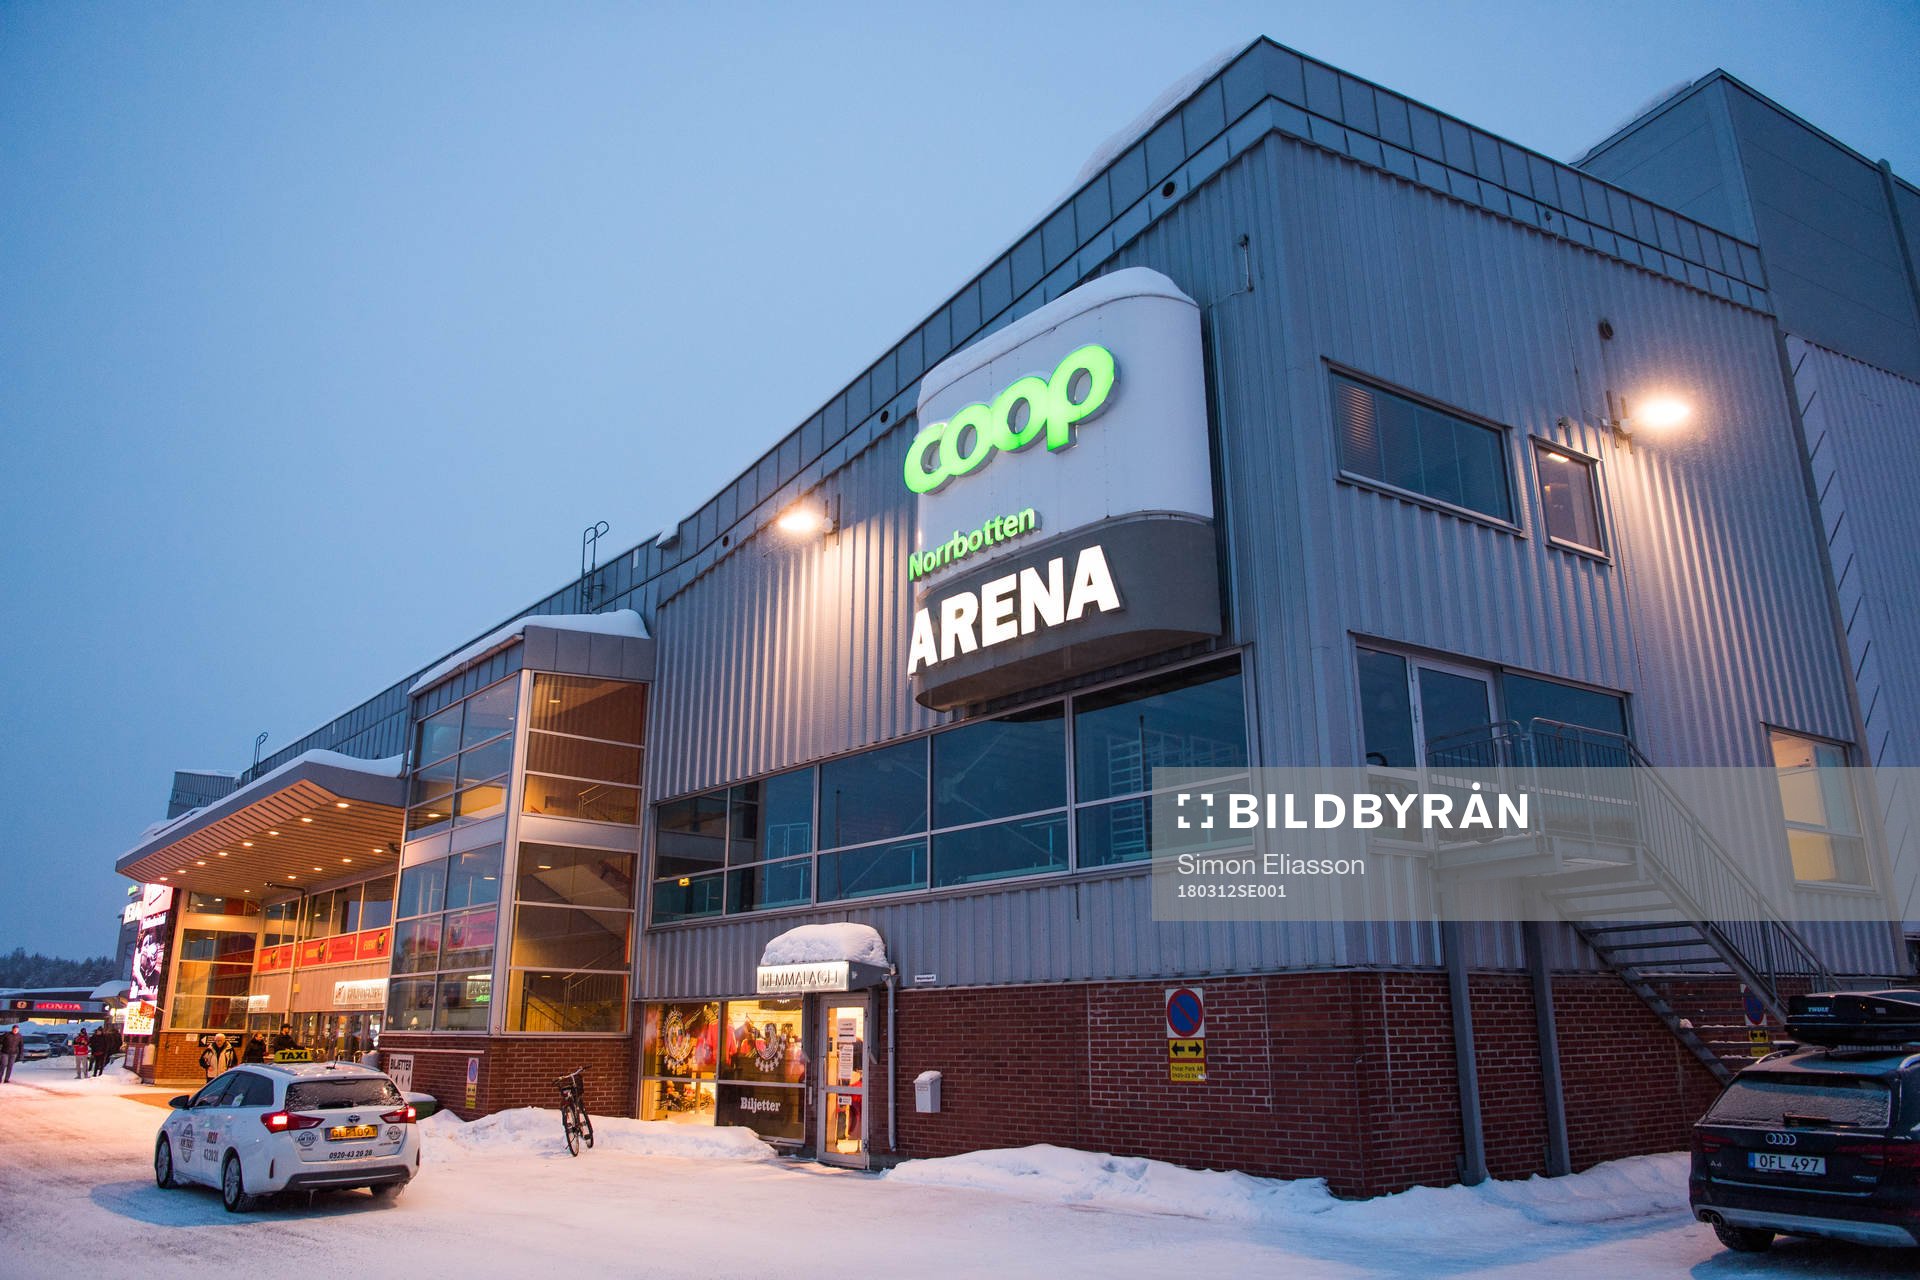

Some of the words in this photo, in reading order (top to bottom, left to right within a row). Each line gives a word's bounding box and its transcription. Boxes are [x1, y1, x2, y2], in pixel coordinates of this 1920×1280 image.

[904, 344, 1116, 494] coop
[908, 507, 1038, 582] Norrbotten
[907, 545, 1121, 676] ARENA
[35, 1002, 82, 1011] HONDA
[280, 1050, 308, 1060] TAXI
[740, 1096, 781, 1114] Biljetter
[1759, 1155, 1786, 1169] OFL
[1791, 1158, 1819, 1171] 497
